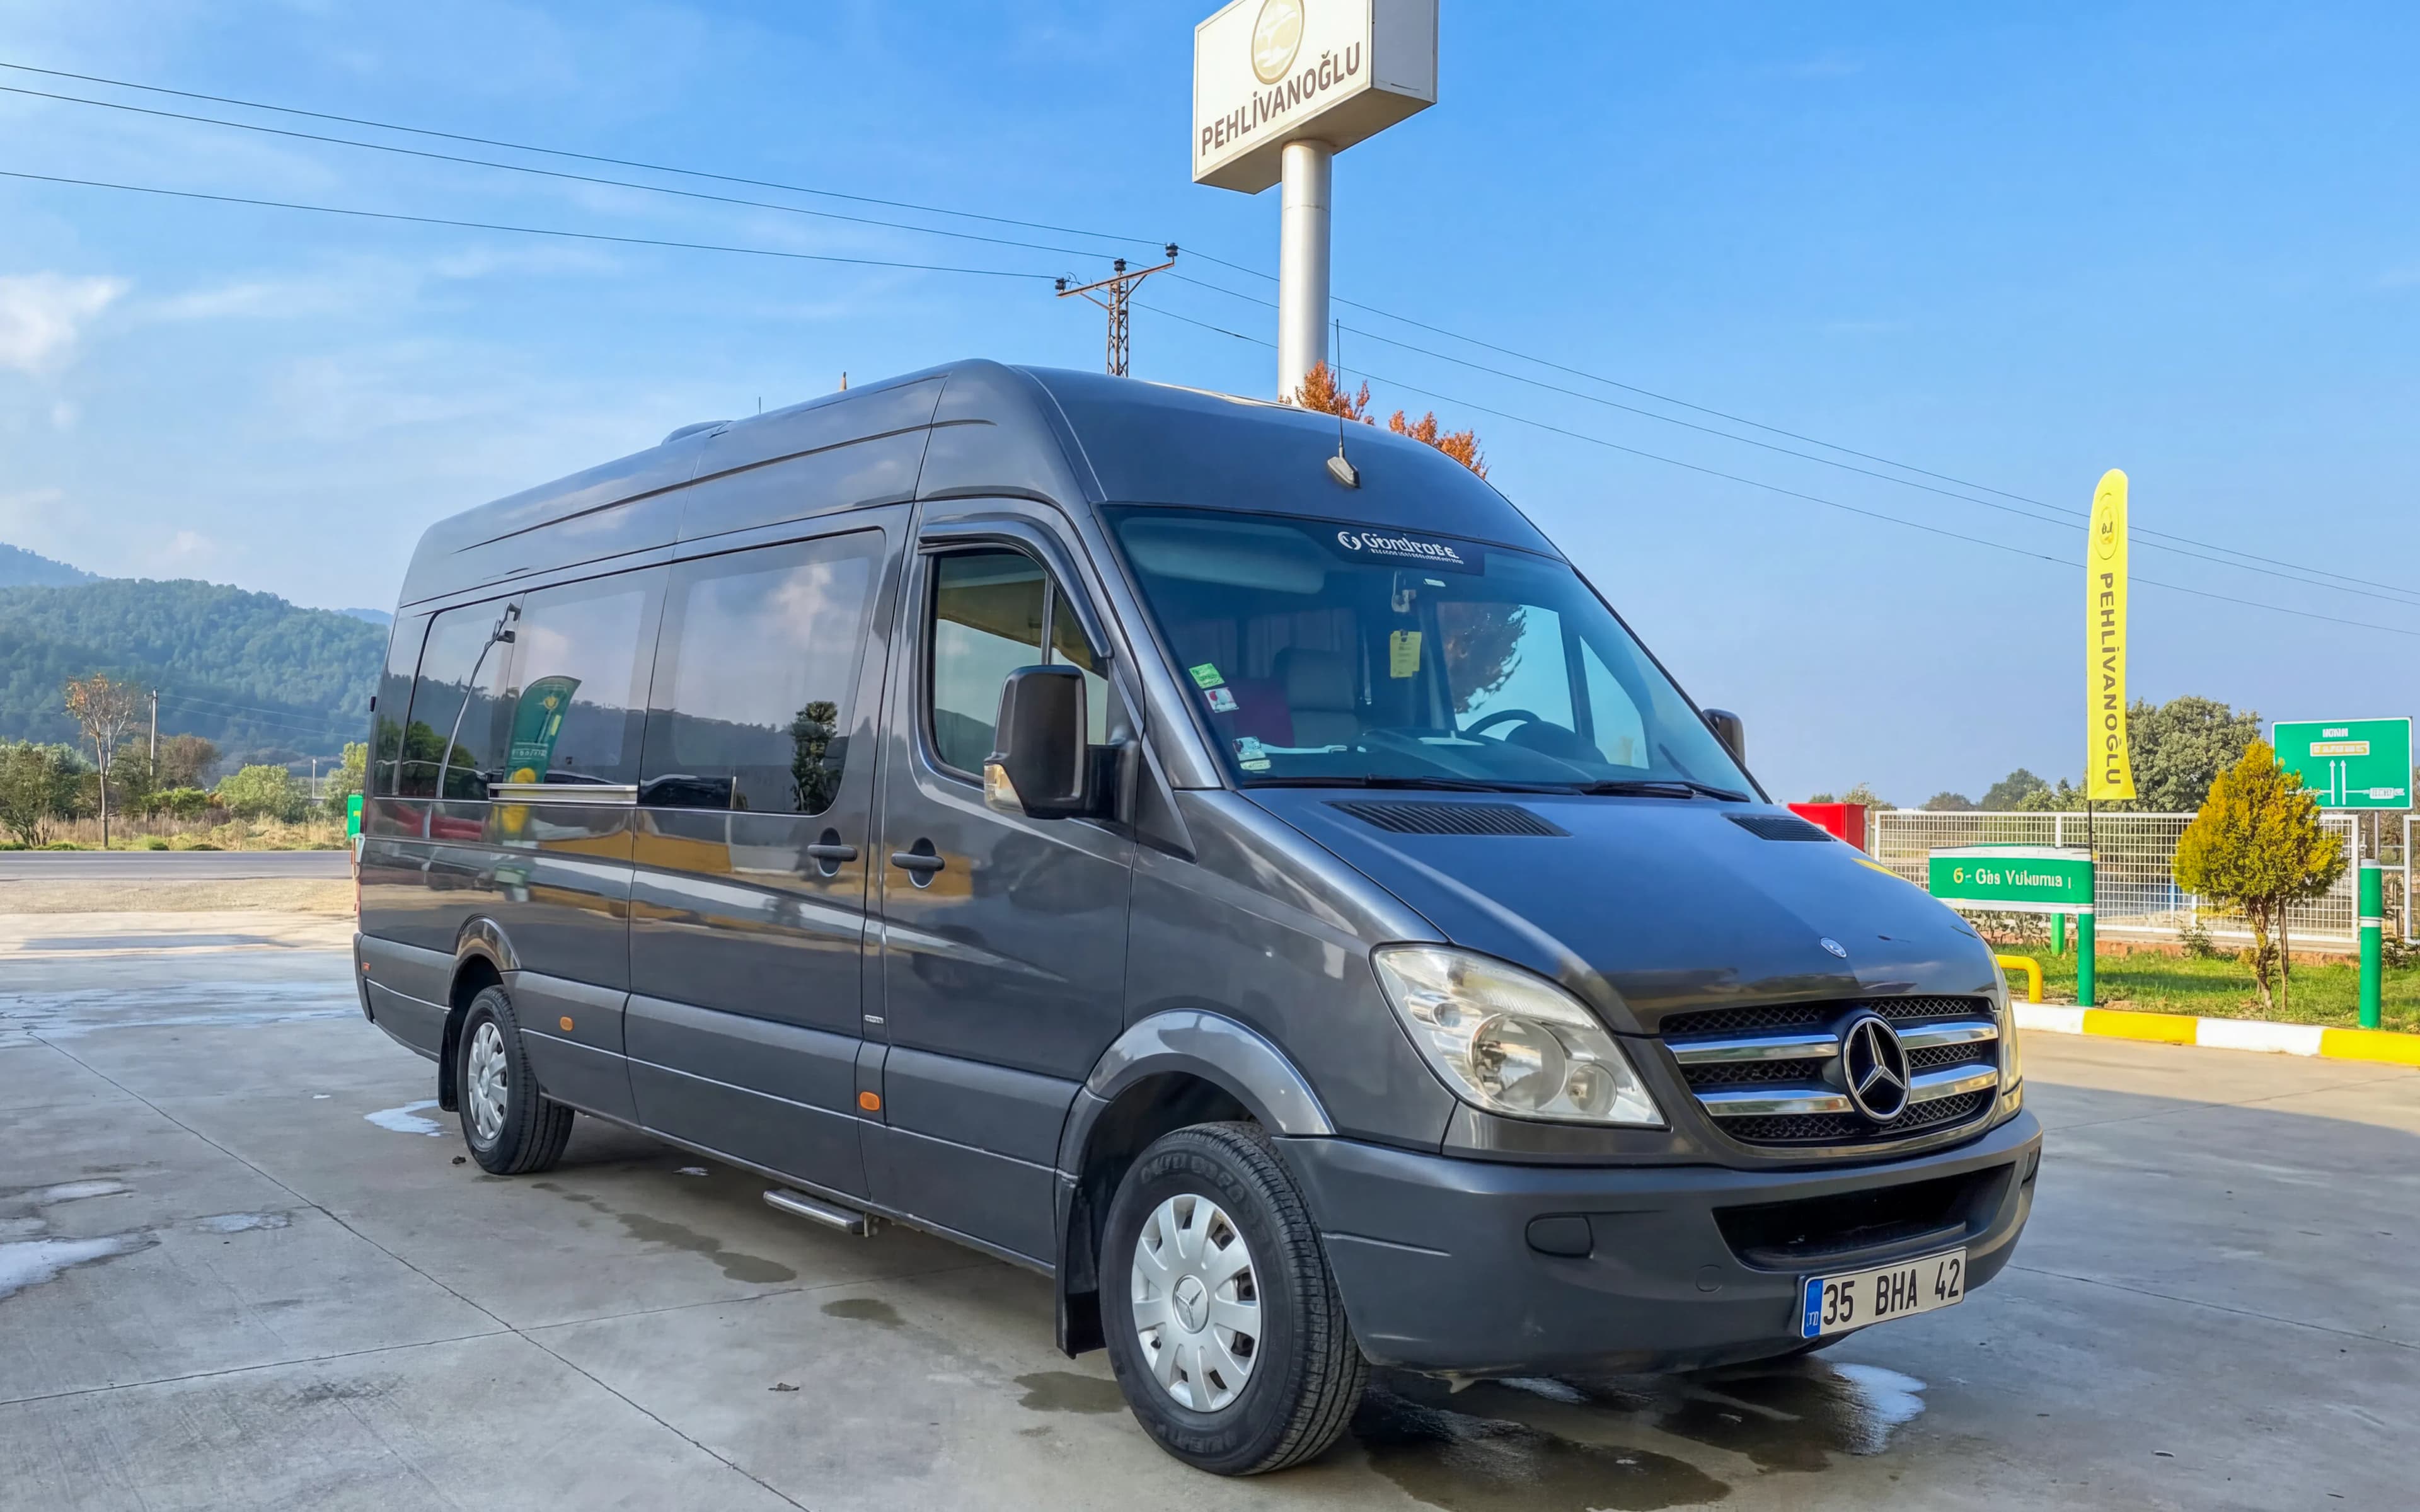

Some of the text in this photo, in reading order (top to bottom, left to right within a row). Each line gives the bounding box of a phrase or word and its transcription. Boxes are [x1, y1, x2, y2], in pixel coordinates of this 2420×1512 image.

[1202, 42, 1361, 157] PEHLİVANOĞLU
[2100, 573, 2122, 785] PEHLİVANOĞLU
[1823, 1259, 1961, 1326] 35 BHA 42
